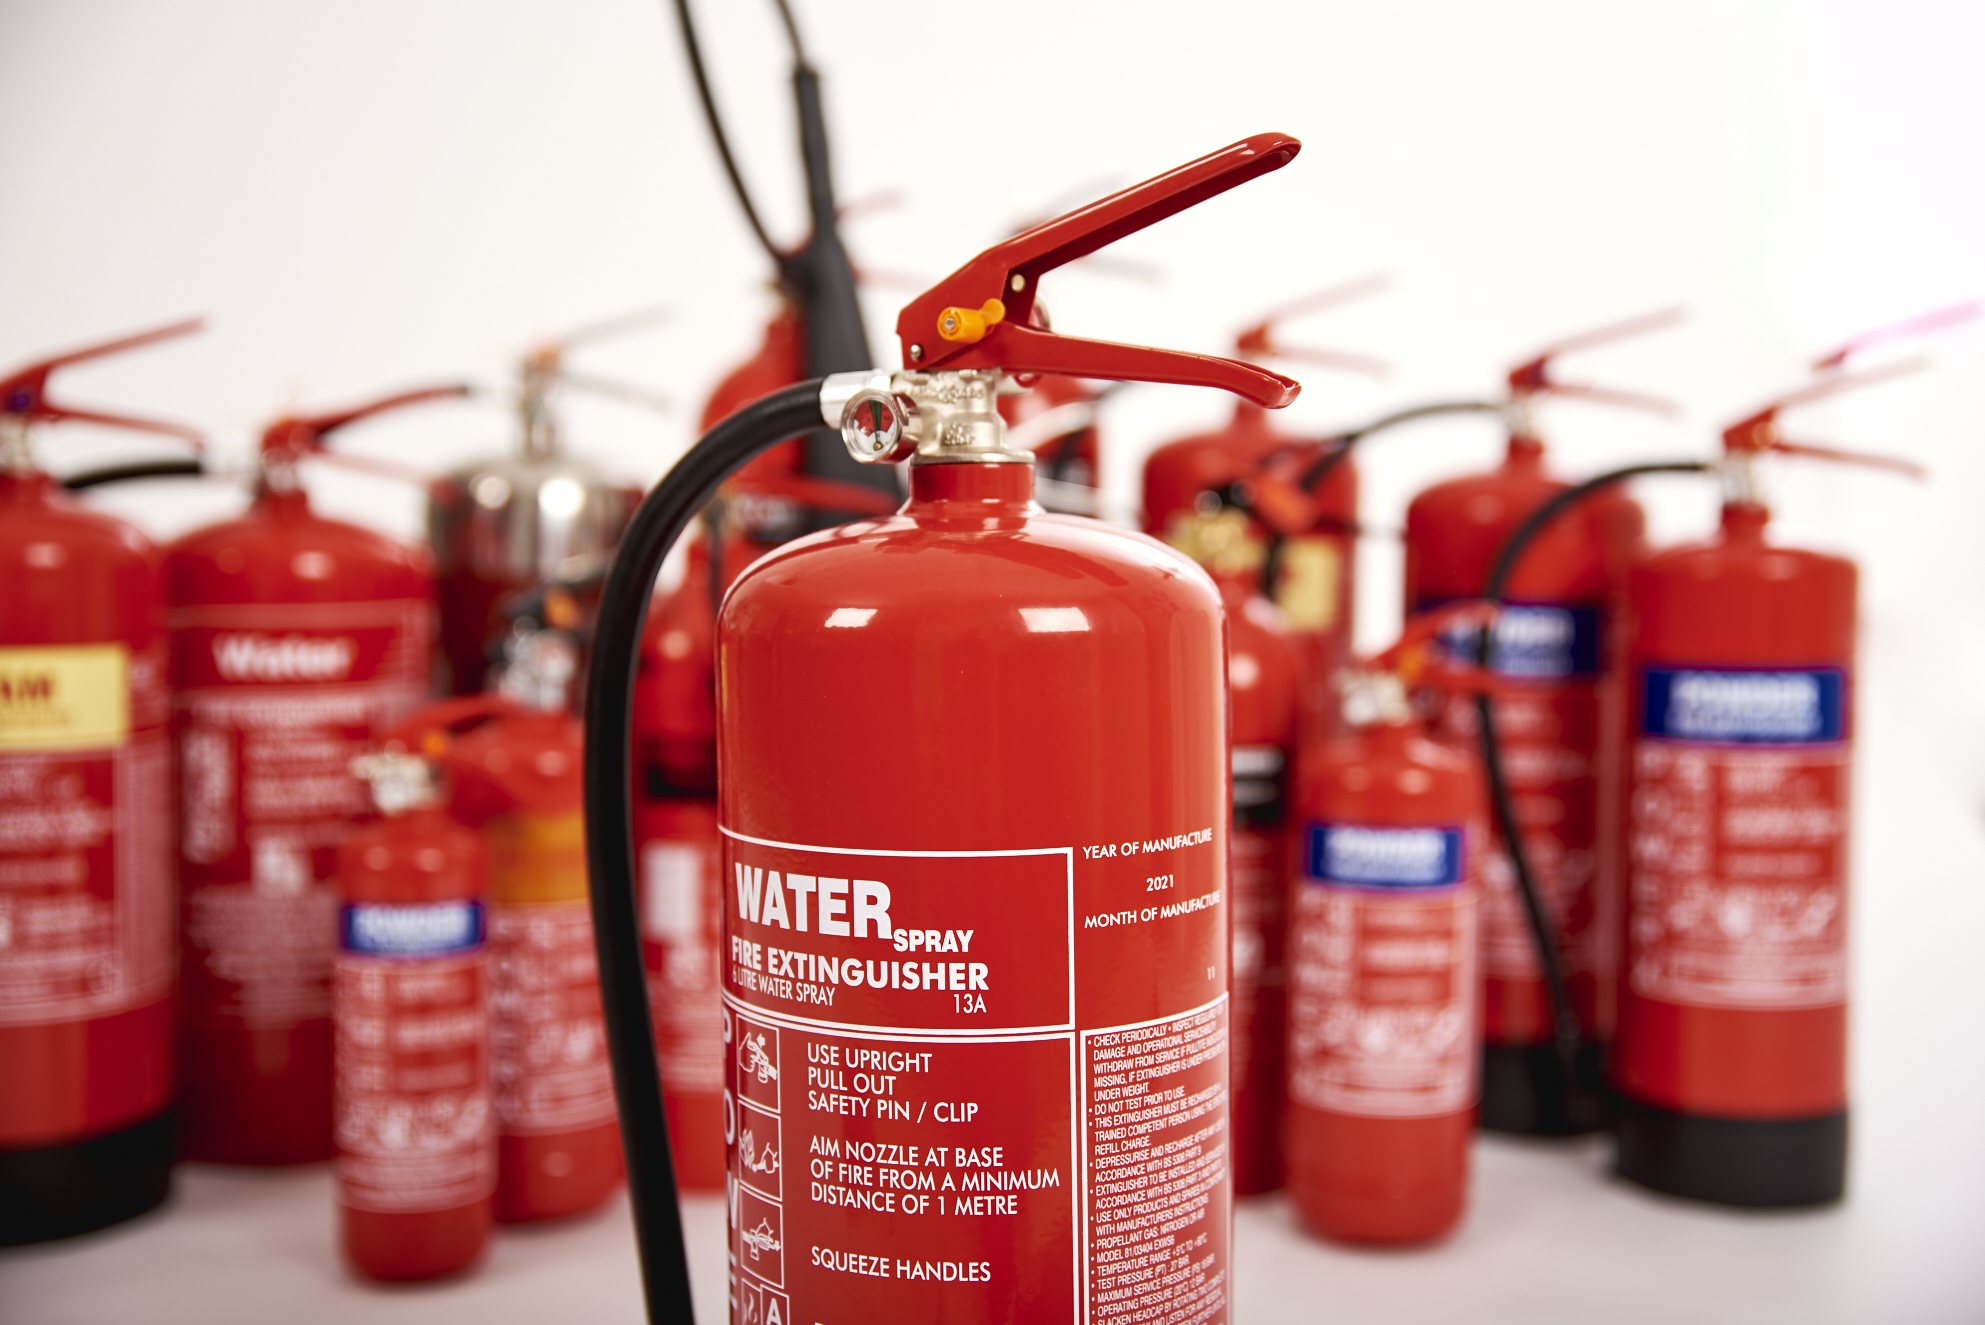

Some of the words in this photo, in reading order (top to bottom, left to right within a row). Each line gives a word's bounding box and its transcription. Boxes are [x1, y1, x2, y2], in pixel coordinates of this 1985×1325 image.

[1083, 844, 1117, 859] YEAR
[1121, 842, 1139, 856] OF
[1142, 828, 1213, 853] MANUFACTURE
[1146, 874, 1174, 892] 2021
[735, 862, 893, 939] WATER
[1084, 910, 1137, 929] MONTH
[1140, 907, 1158, 922] OF
[1160, 889, 1221, 919] MANUFACTURE
[893, 928, 974, 953] SPRAY
[732, 935, 762, 971] FIRE
[768, 946, 989, 990] EXTINGUISHER
[1207, 966, 1216, 980] 11
[738, 966, 757, 991] LITRE
[758, 974, 793, 1000] WATER
[796, 981, 835, 1006] SPRAY
[953, 993, 987, 1014] 13A
[1094, 1034, 1120, 1048] CHECK
[1122, 1024, 1168, 1043] PERIODICALLY
[1172, 1017, 1195, 1033] INSPECT
[1094, 1046, 1126, 1061] DAMAGE
[1127, 1042, 1142, 1056] AND
[1142, 1034, 1184, 1053] OPERATIONAL
[807, 1042, 839, 1067] USE
[845, 1048, 933, 1073] UPRIGHT
[1094, 1060, 1134, 1074] WITHDRAW
[1135, 1054, 1154, 1072] FROM
[1155, 1048, 1180, 1064] SERVICE
[808, 1066, 848, 1092] PULL
[853, 1073, 896, 1096] OUT
[1094, 1073, 1128, 1088] MISSING,
[1128, 1071, 1136, 1082] IF
[1136, 1061, 1180, 1082] EXTINGUISHER
[808, 1090, 871, 1116] SAFETY
[877, 1099, 910, 1121] PIN
[917, 1101, 927, 1124] /
[934, 1102, 979, 1123] CLIP
[1094, 1088, 1120, 1102] UNDER
[1122, 1082, 1150, 1098] WEIGHT.
[1094, 1104, 1106, 1116] DO
[1108, 1100, 1124, 1114] NOT
[1125, 1096, 1142, 1110] TEST
[1144, 1092, 1163, 1108] PRIOR
[1163, 1090, 1172, 1101] TO
[1095, 1116, 1112, 1129] THIS
[1114, 1106, 1162, 1126] EXTINGUISHER
[1163, 1102, 1180, 1116] MUST
[1180, 1098, 1188, 1110] BE
[1095, 1129, 1126, 1143] TRAINED
[1128, 1118, 1168, 1140] COMPETENT
[1168, 1112, 1190, 1128] PERSON
[810, 1135, 840, 1158] AIM
[846, 1141, 919, 1166] NOZZLE
[924, 1146, 949, 1167] AT
[956, 1146, 1004, 1168] BASE
[1095, 1142, 1120, 1156] REFILL
[1120, 1136, 1152, 1152] CHARGE.
[1096, 1148, 1150, 1170] DEPRESSURISE
[1150, 1145, 1164, 1158] AND
[1164, 1134, 1194, 1154] RECHARGE
[810, 1158, 834, 1179] OF
[839, 1163, 873, 1187] FIRE
[880, 1168, 936, 1191] FROM
[940, 1171, 956, 1191] A
[962, 1168, 1061, 1192] MINIMUM
[1095, 1164, 1146, 1183] ACCORDANCE
[1146, 1160, 1162, 1173] WITH
[1163, 1156, 1172, 1168] BS
[1096, 1176, 1148, 1196] EXTINGUISHER
[1148, 1174, 1158, 1186] TO
[1158, 1170, 1168, 1183] BE
[1168, 1160, 1196, 1180] INSTALLED
[811, 1182, 896, 1213] DISTANCE
[902, 1193, 930, 1214] OF
[938, 1195, 946, 1216] 1
[954, 1194, 1018, 1216] METRE
[1096, 1190, 1146, 1210] ACCORDANCE
[1146, 1186, 1162, 1200] WITH
[1163, 1183, 1172, 1196] BS
[1096, 1210, 1112, 1224] USE
[1113, 1207, 1132, 1220] ONLY
[1133, 1196, 1168, 1216] PRODUCTS
[1168, 1193, 1180, 1205] AND
[1096, 1224, 1116, 1237] WITH
[1116, 1208, 1174, 1233] MANUFACTURERS
[1096, 1230, 1143, 1250] PROPELLANT
[1160, 1218, 1189, 1236] NITROGEN
[811, 1246, 890, 1278] SQUEEZE
[896, 1259, 991, 1282] HANDLES
[1096, 1250, 1124, 1264] MODEL
[1096, 1258, 1148, 1277] TEMPERATURE
[1150, 1248, 1172, 1265] RANGE
[1097, 1276, 1116, 1290] TEST
[1118, 1267, 1154, 1286] PRESSURE
[1097, 1287, 1133, 1304] MAXIMUM
[1134, 1278, 1162, 1297] SERVICE
[1162, 1266, 1191, 1288] PRESSURE
[1098, 1298, 1139, 1318] OPERATING
[1140, 1288, 1173, 1308] PRESSURE
[1132, 1304, 1163, 1322] HEADCAP
